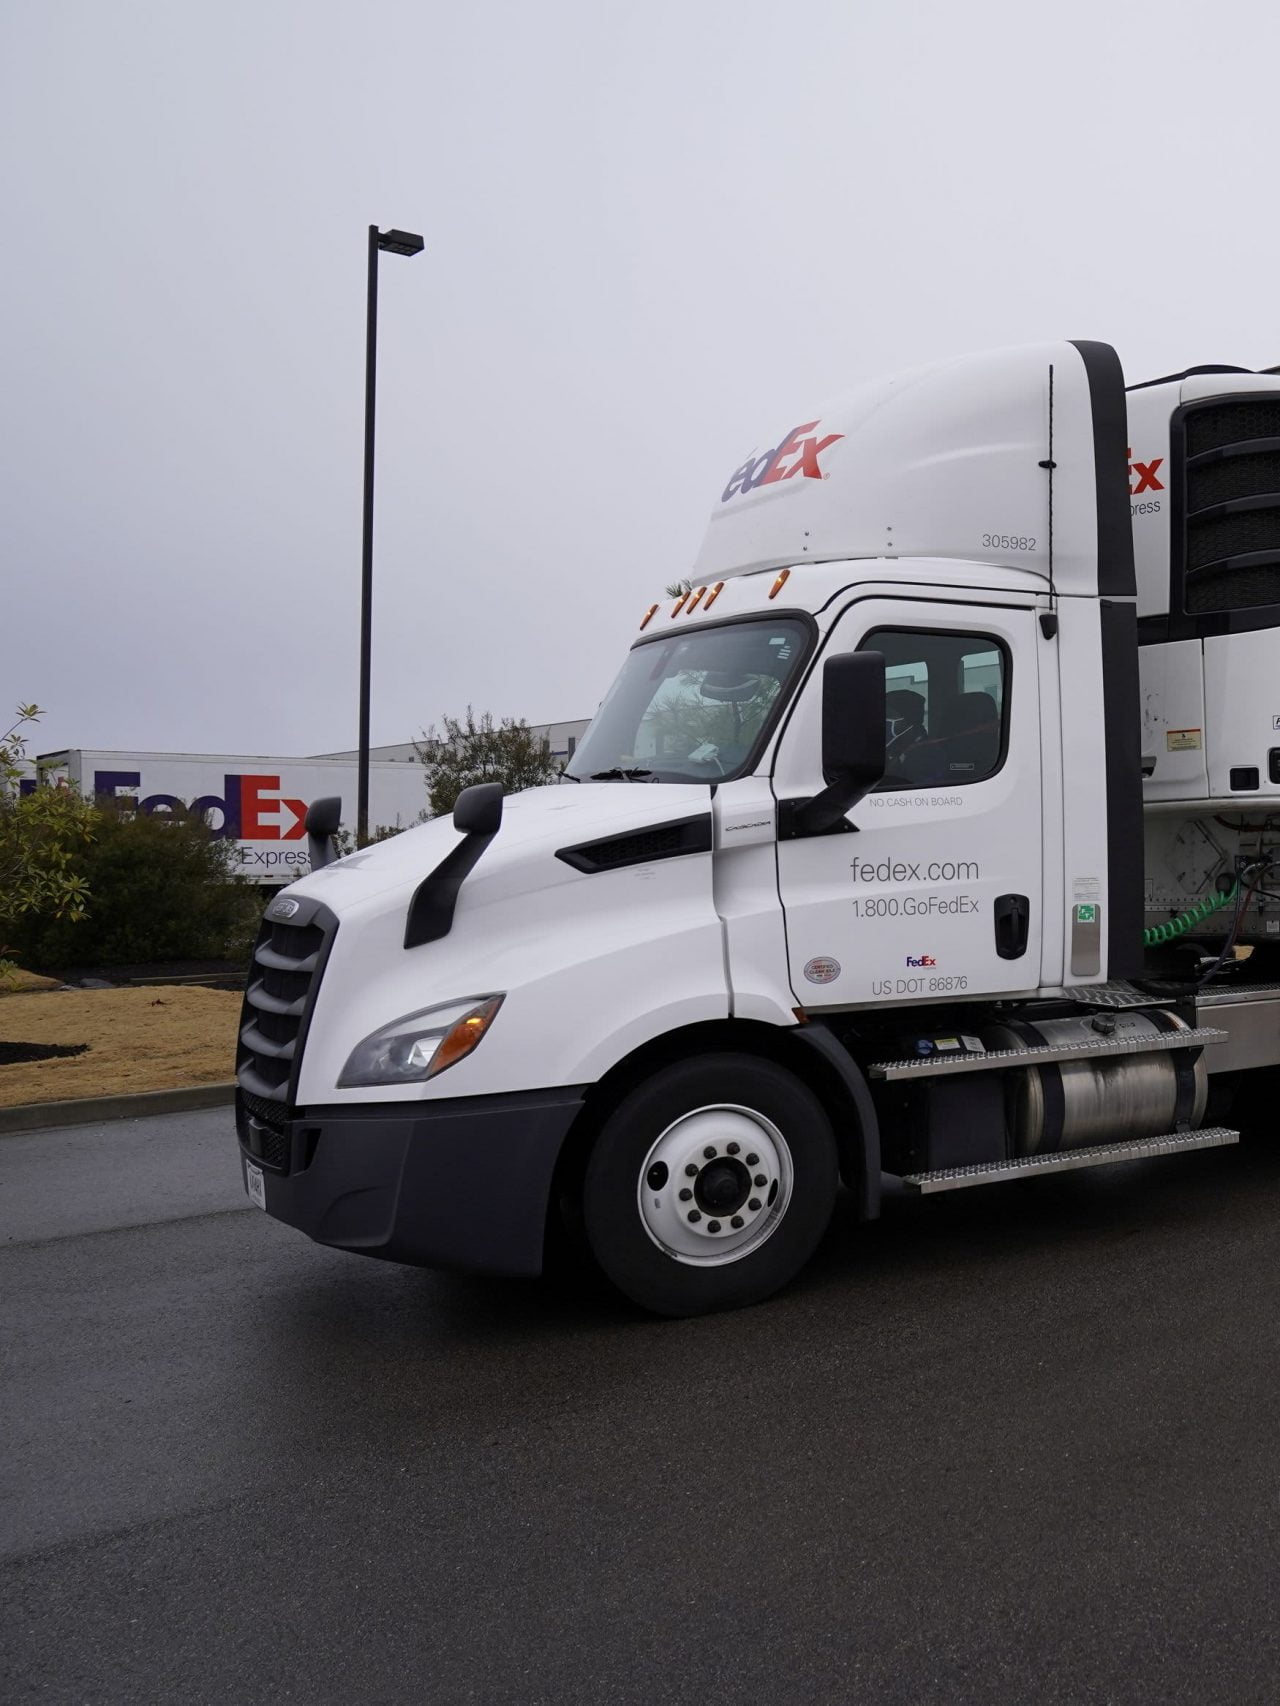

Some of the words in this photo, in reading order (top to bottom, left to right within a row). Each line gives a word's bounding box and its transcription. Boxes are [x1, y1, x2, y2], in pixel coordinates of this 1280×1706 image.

[721, 420, 846, 502] edEx
[982, 534, 1037, 551] 305982
[869, 798, 884, 807] NO
[887, 798, 912, 807] CASH
[914, 798, 930, 806] ON
[931, 797, 963, 806] BOARD
[850, 857, 979, 882] fedex.com
[853, 896, 979, 917] 1.800.GoFedEx
[906, 955, 937, 967] FedEx
[872, 980, 893, 996] US
[896, 978, 925, 994] DOT
[928, 976, 968, 992] 86876
